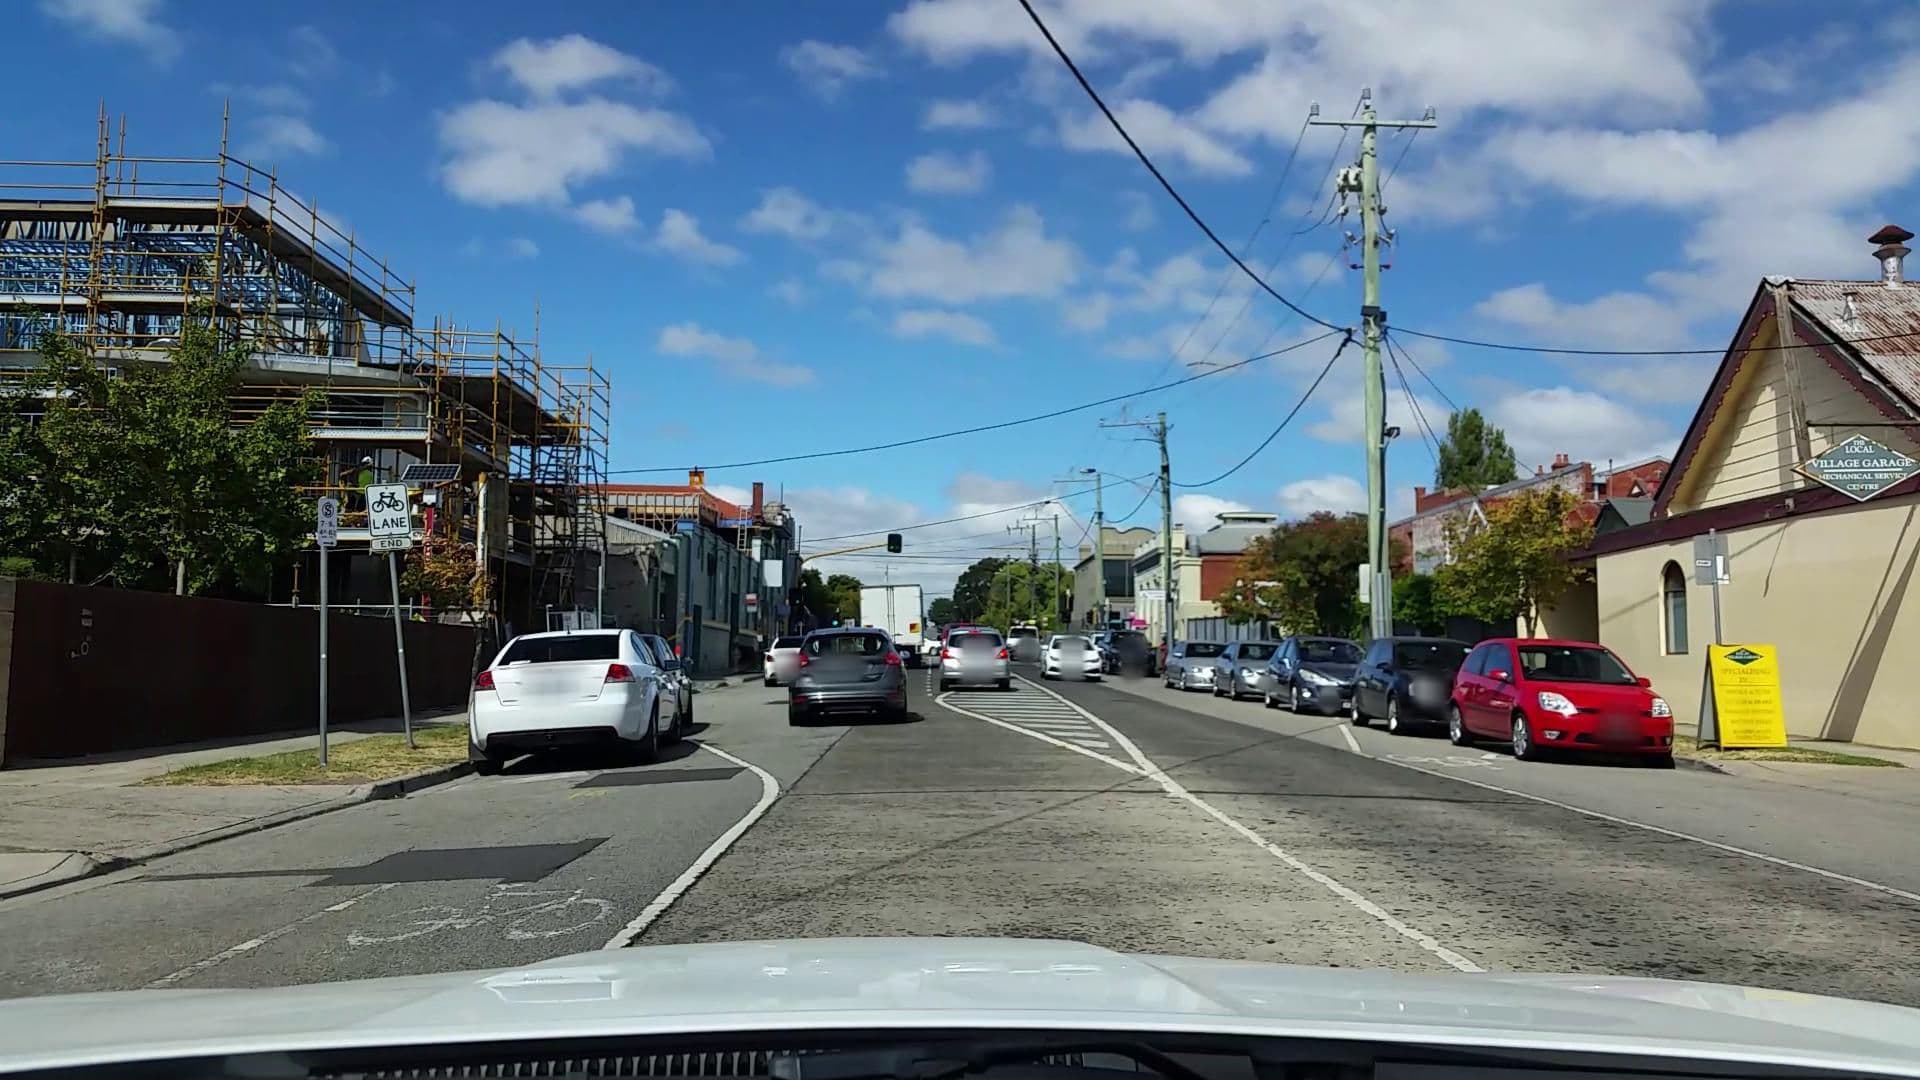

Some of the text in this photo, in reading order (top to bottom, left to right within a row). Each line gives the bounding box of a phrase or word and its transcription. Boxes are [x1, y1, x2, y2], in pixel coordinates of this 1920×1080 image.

[1845, 445, 1875, 454] LOCAL
[1812, 458, 1912, 469] VILLAGE GARAGE
[1818, 472, 1873, 481] MECHANICAL
[1846, 483, 1880, 491] CENTRE
[373, 517, 407, 530] LANE
[380, 540, 402, 548] END
